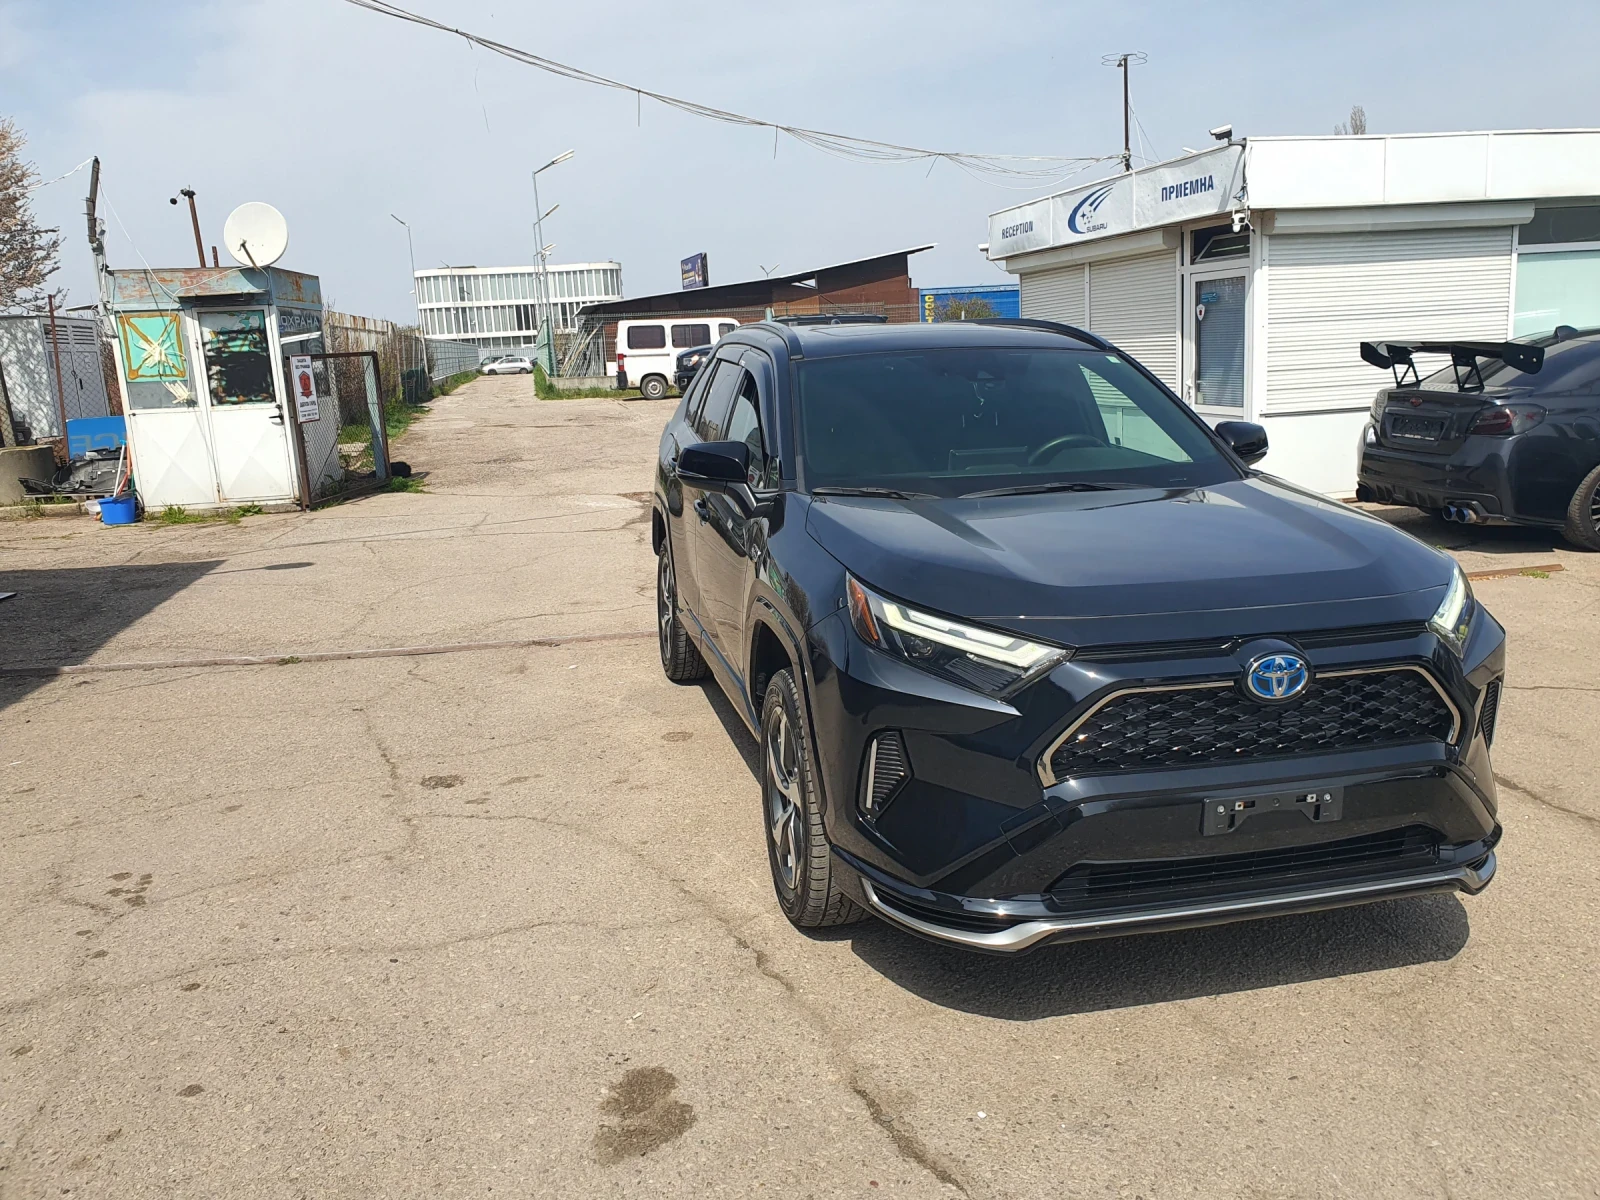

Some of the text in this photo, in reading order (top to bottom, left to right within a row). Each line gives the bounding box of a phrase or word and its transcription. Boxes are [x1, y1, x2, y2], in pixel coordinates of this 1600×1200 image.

[1161, 174, 1214, 202] ПРИЕМНА
[1001, 220, 1034, 239] RECEPTION
[1086, 222, 1108, 233] SUBARU
[280, 315, 320, 328] ОХРАНА
